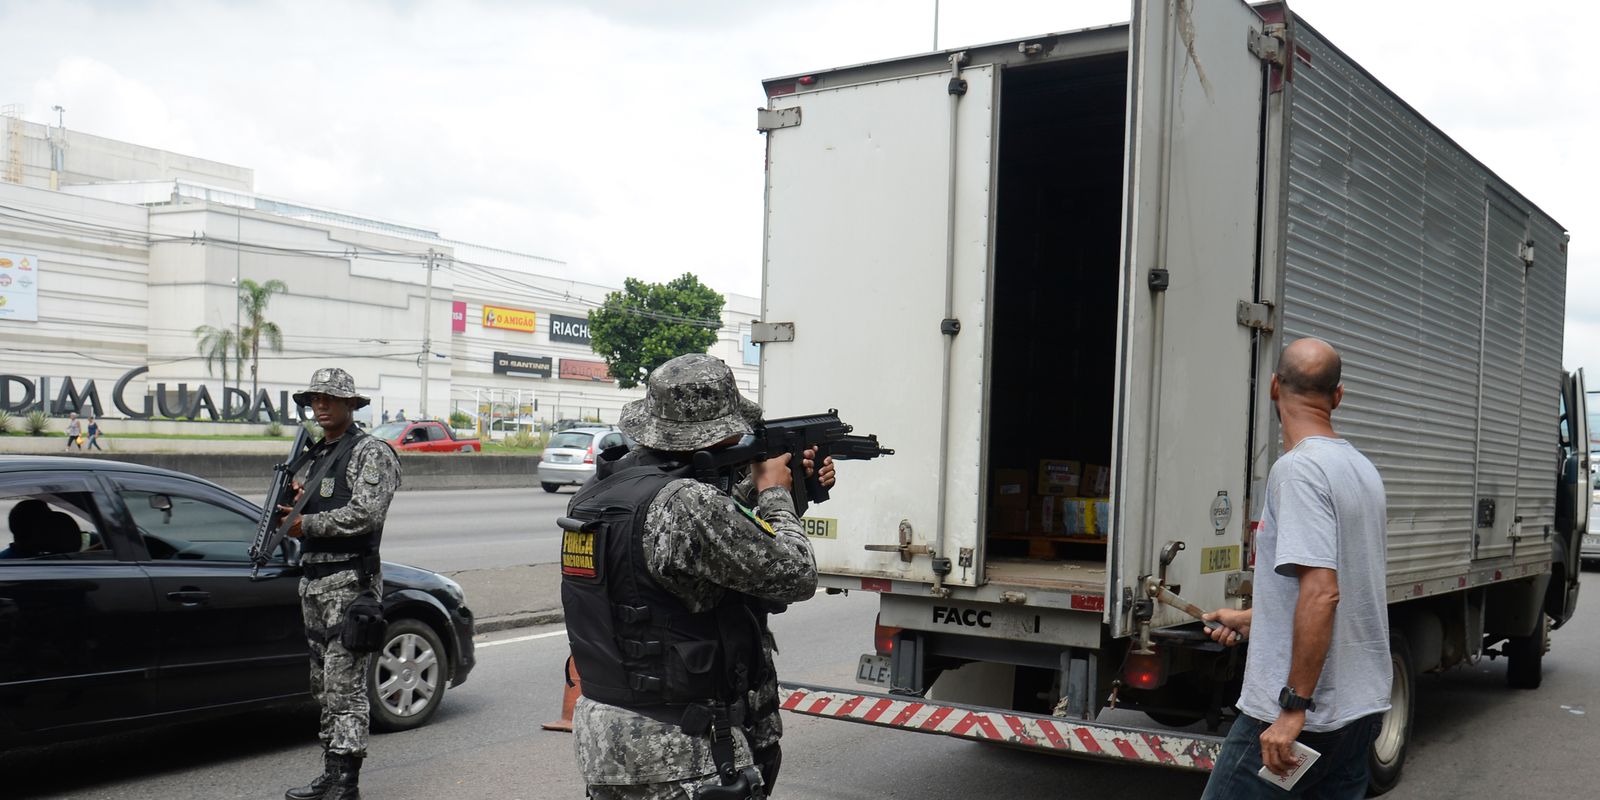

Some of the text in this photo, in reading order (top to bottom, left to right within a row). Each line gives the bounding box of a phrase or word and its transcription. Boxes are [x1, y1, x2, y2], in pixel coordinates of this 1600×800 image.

[496, 314, 503, 323] O
[499, 359, 550, 370] DI SANTINNI
